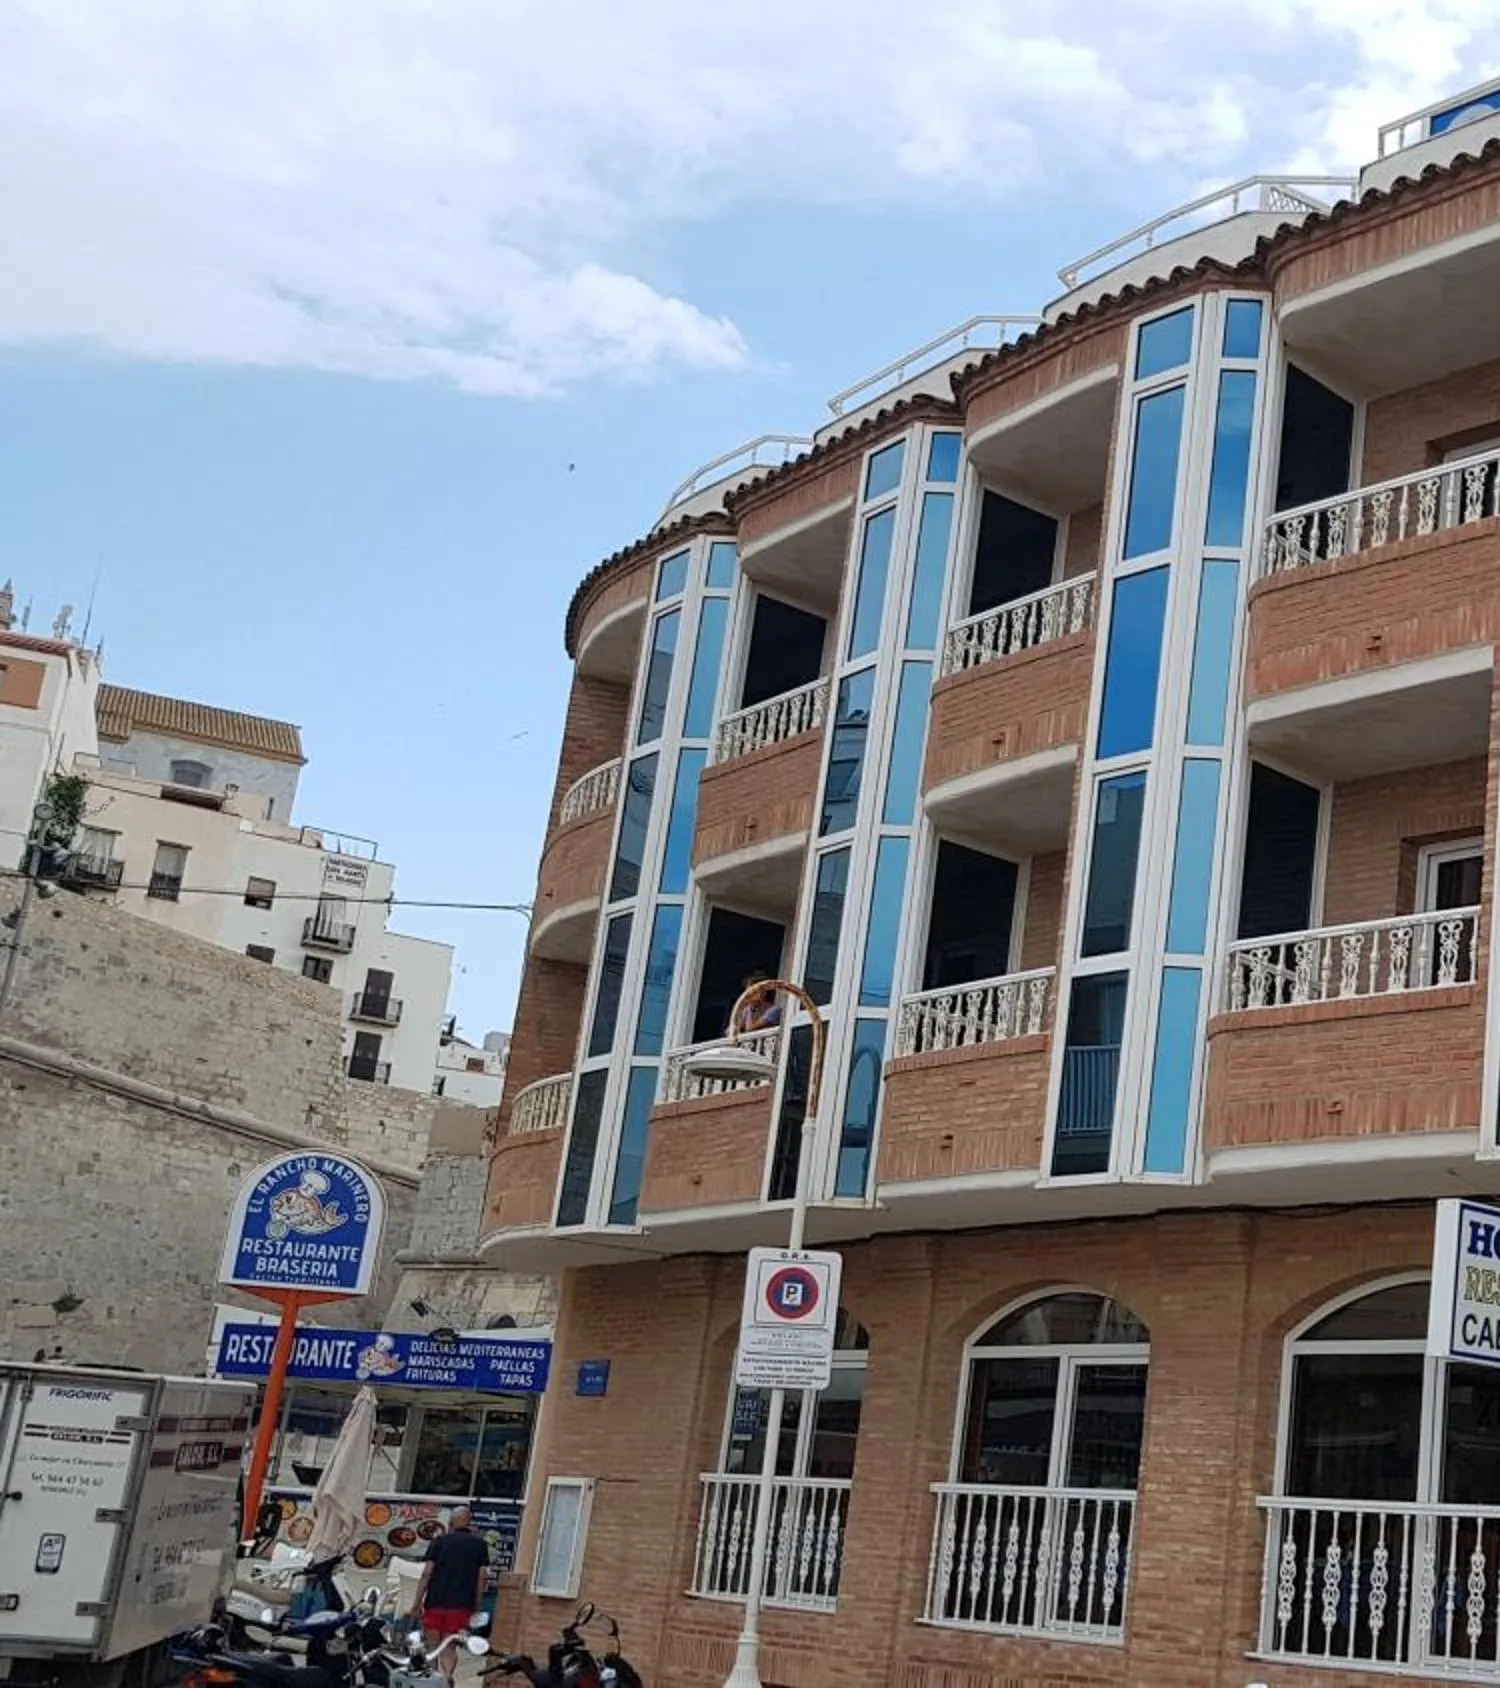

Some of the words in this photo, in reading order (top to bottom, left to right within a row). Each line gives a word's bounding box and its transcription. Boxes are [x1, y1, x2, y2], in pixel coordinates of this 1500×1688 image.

[248, 1197, 264, 1213] EL
[262, 1159, 317, 1195] RANCHO
[322, 1160, 369, 1223] MARINERO
[241, 1237, 361, 1263] RESTAURANTE
[255, 1257, 339, 1278] BRASERIA
[226, 1334, 356, 1369] RESTRANTE
[410, 1341, 457, 1355] DELICIAS
[458, 1343, 545, 1360] MEDITERRANEAS
[407, 1355, 476, 1370] MARISCADAS
[489, 1359, 536, 1373] PAELLAS
[405, 1368, 457, 1382] FRITURAS
[499, 1374, 533, 1386] TAPAS
